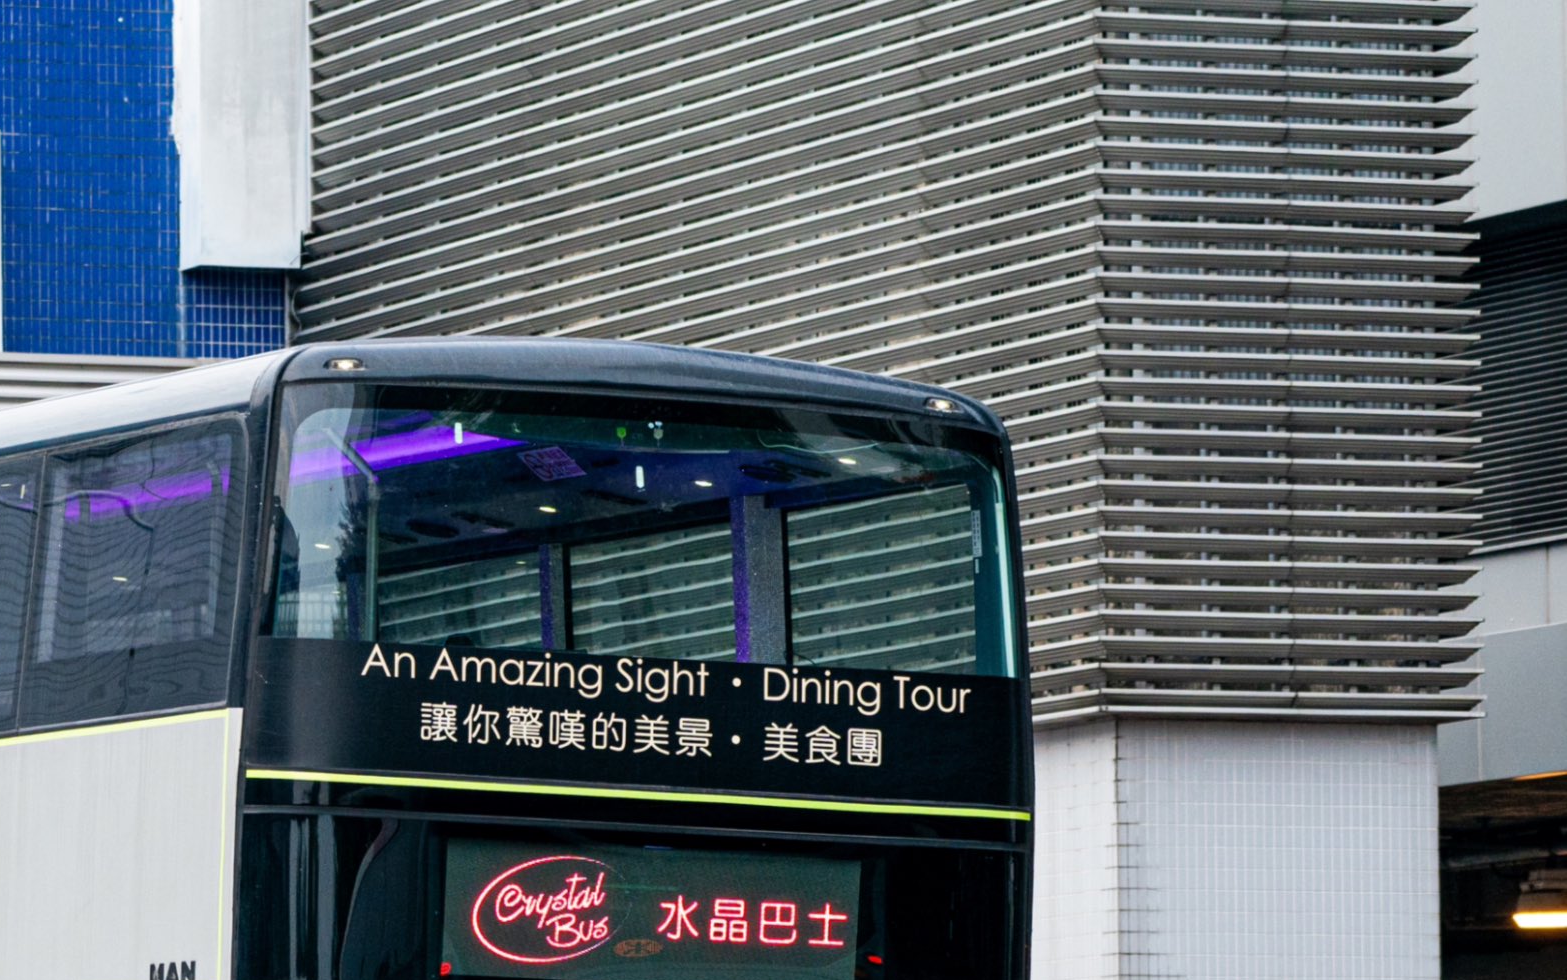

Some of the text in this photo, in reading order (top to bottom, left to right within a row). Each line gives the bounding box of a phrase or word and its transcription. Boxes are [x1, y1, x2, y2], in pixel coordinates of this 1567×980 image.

[360, 642, 416, 679] An
[429, 647, 604, 699] Amazing
[614, 657, 710, 703] Sight
[762, 667, 882, 717] Dining
[893, 675, 973, 714] Tour
[495, 871, 606, 929] Crystal
[655, 894, 849, 948] 水晶巴士
[545, 914, 610, 948] Bus
